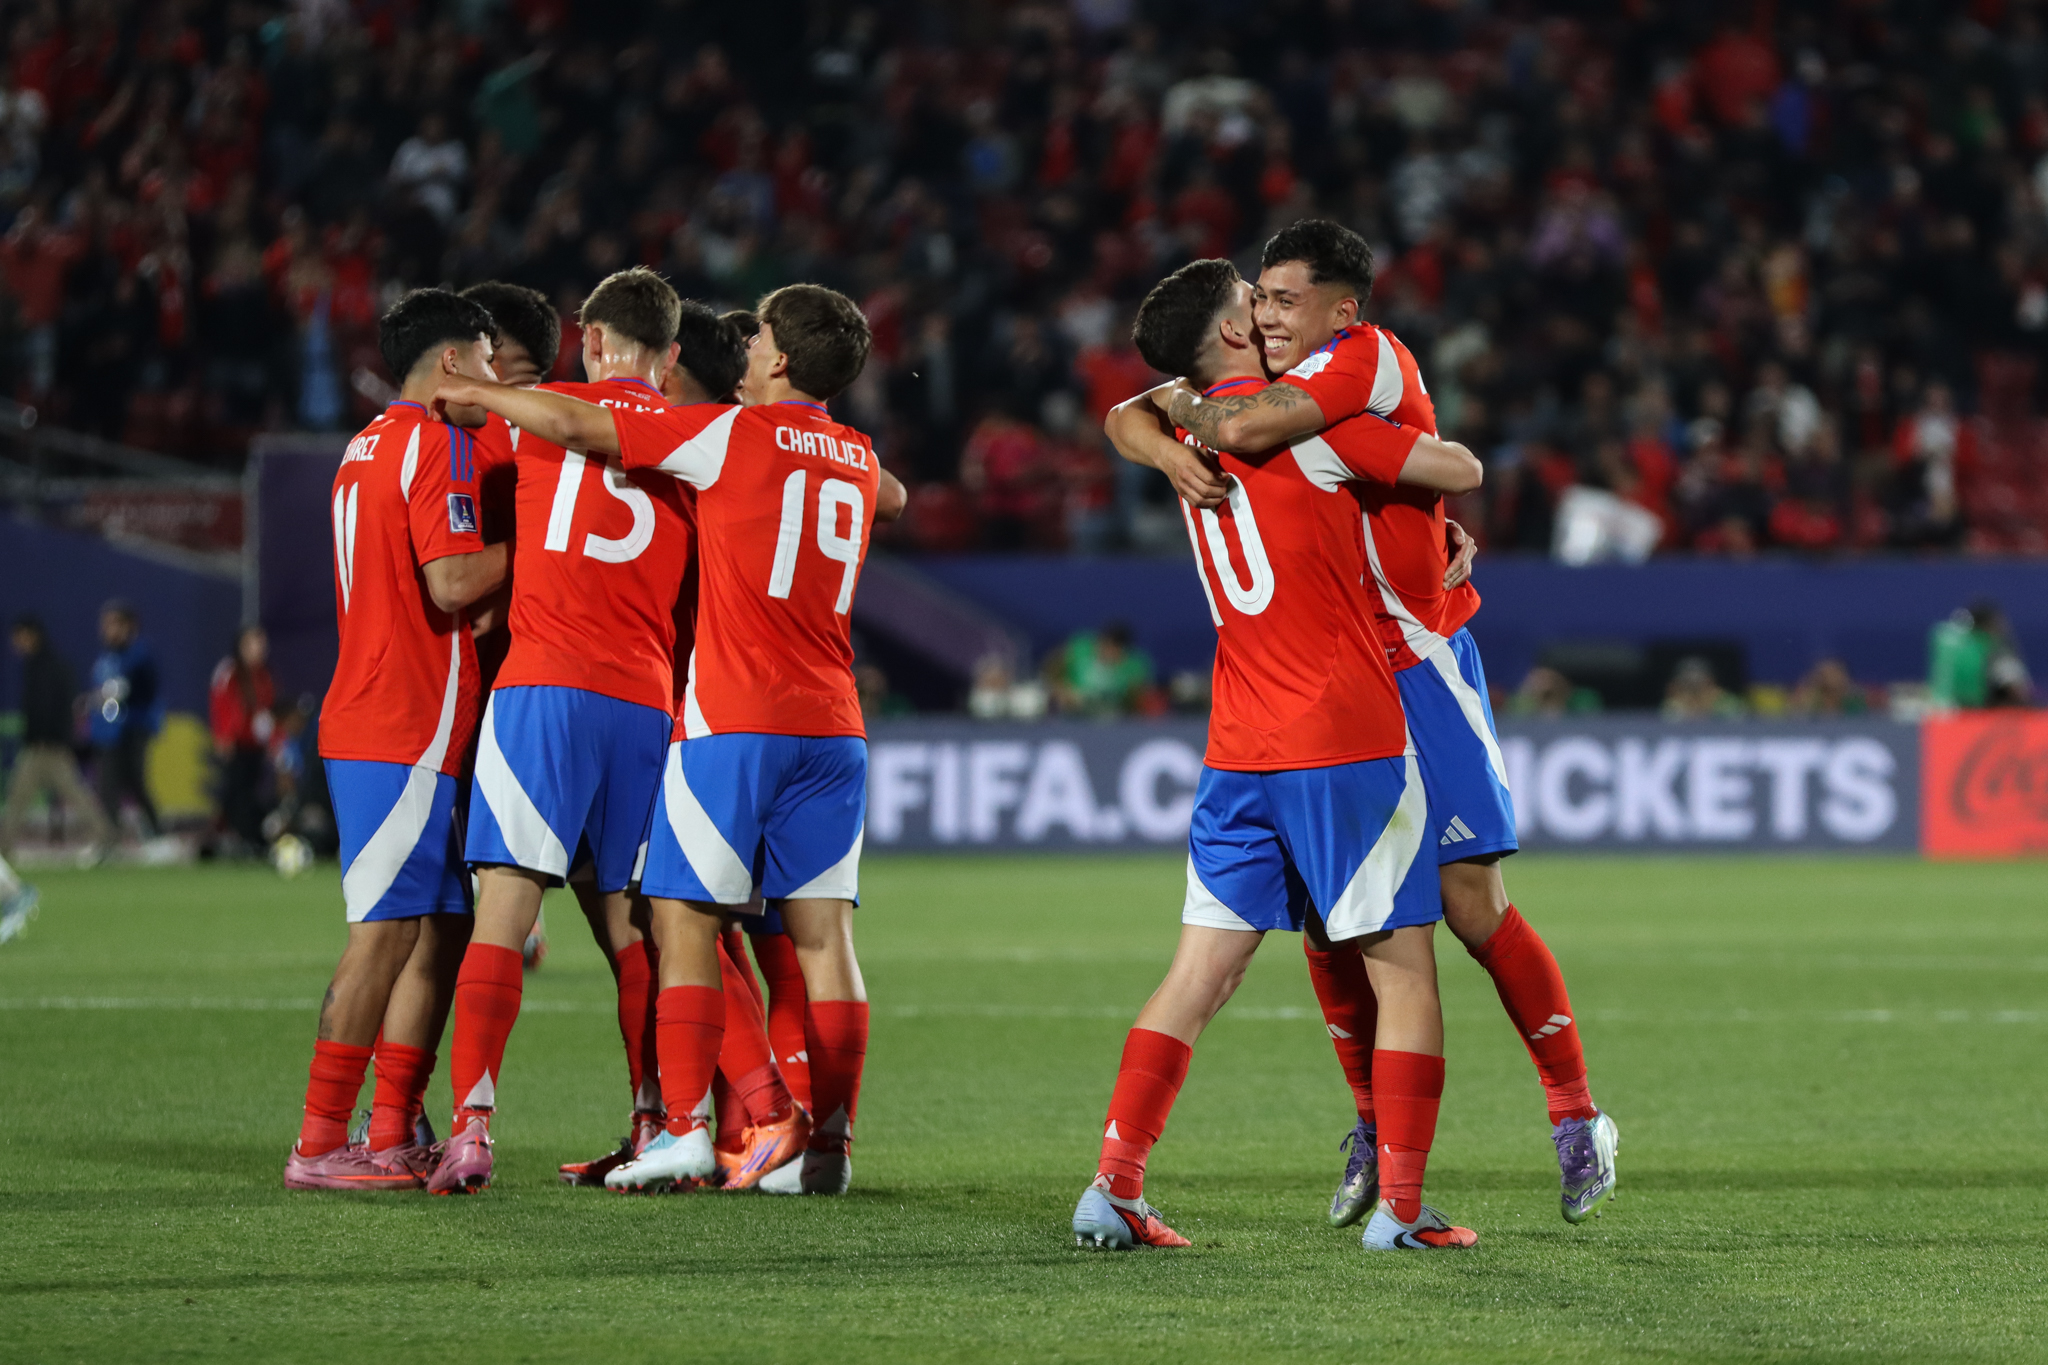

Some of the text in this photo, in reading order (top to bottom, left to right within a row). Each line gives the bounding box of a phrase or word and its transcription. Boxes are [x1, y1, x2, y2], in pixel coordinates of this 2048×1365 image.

[543, 448, 656, 564] 15
[775, 426, 869, 472] CHATILIEZ
[333, 481, 359, 615] 11
[767, 469, 865, 615] 19
[1182, 472, 1275, 627] 10
